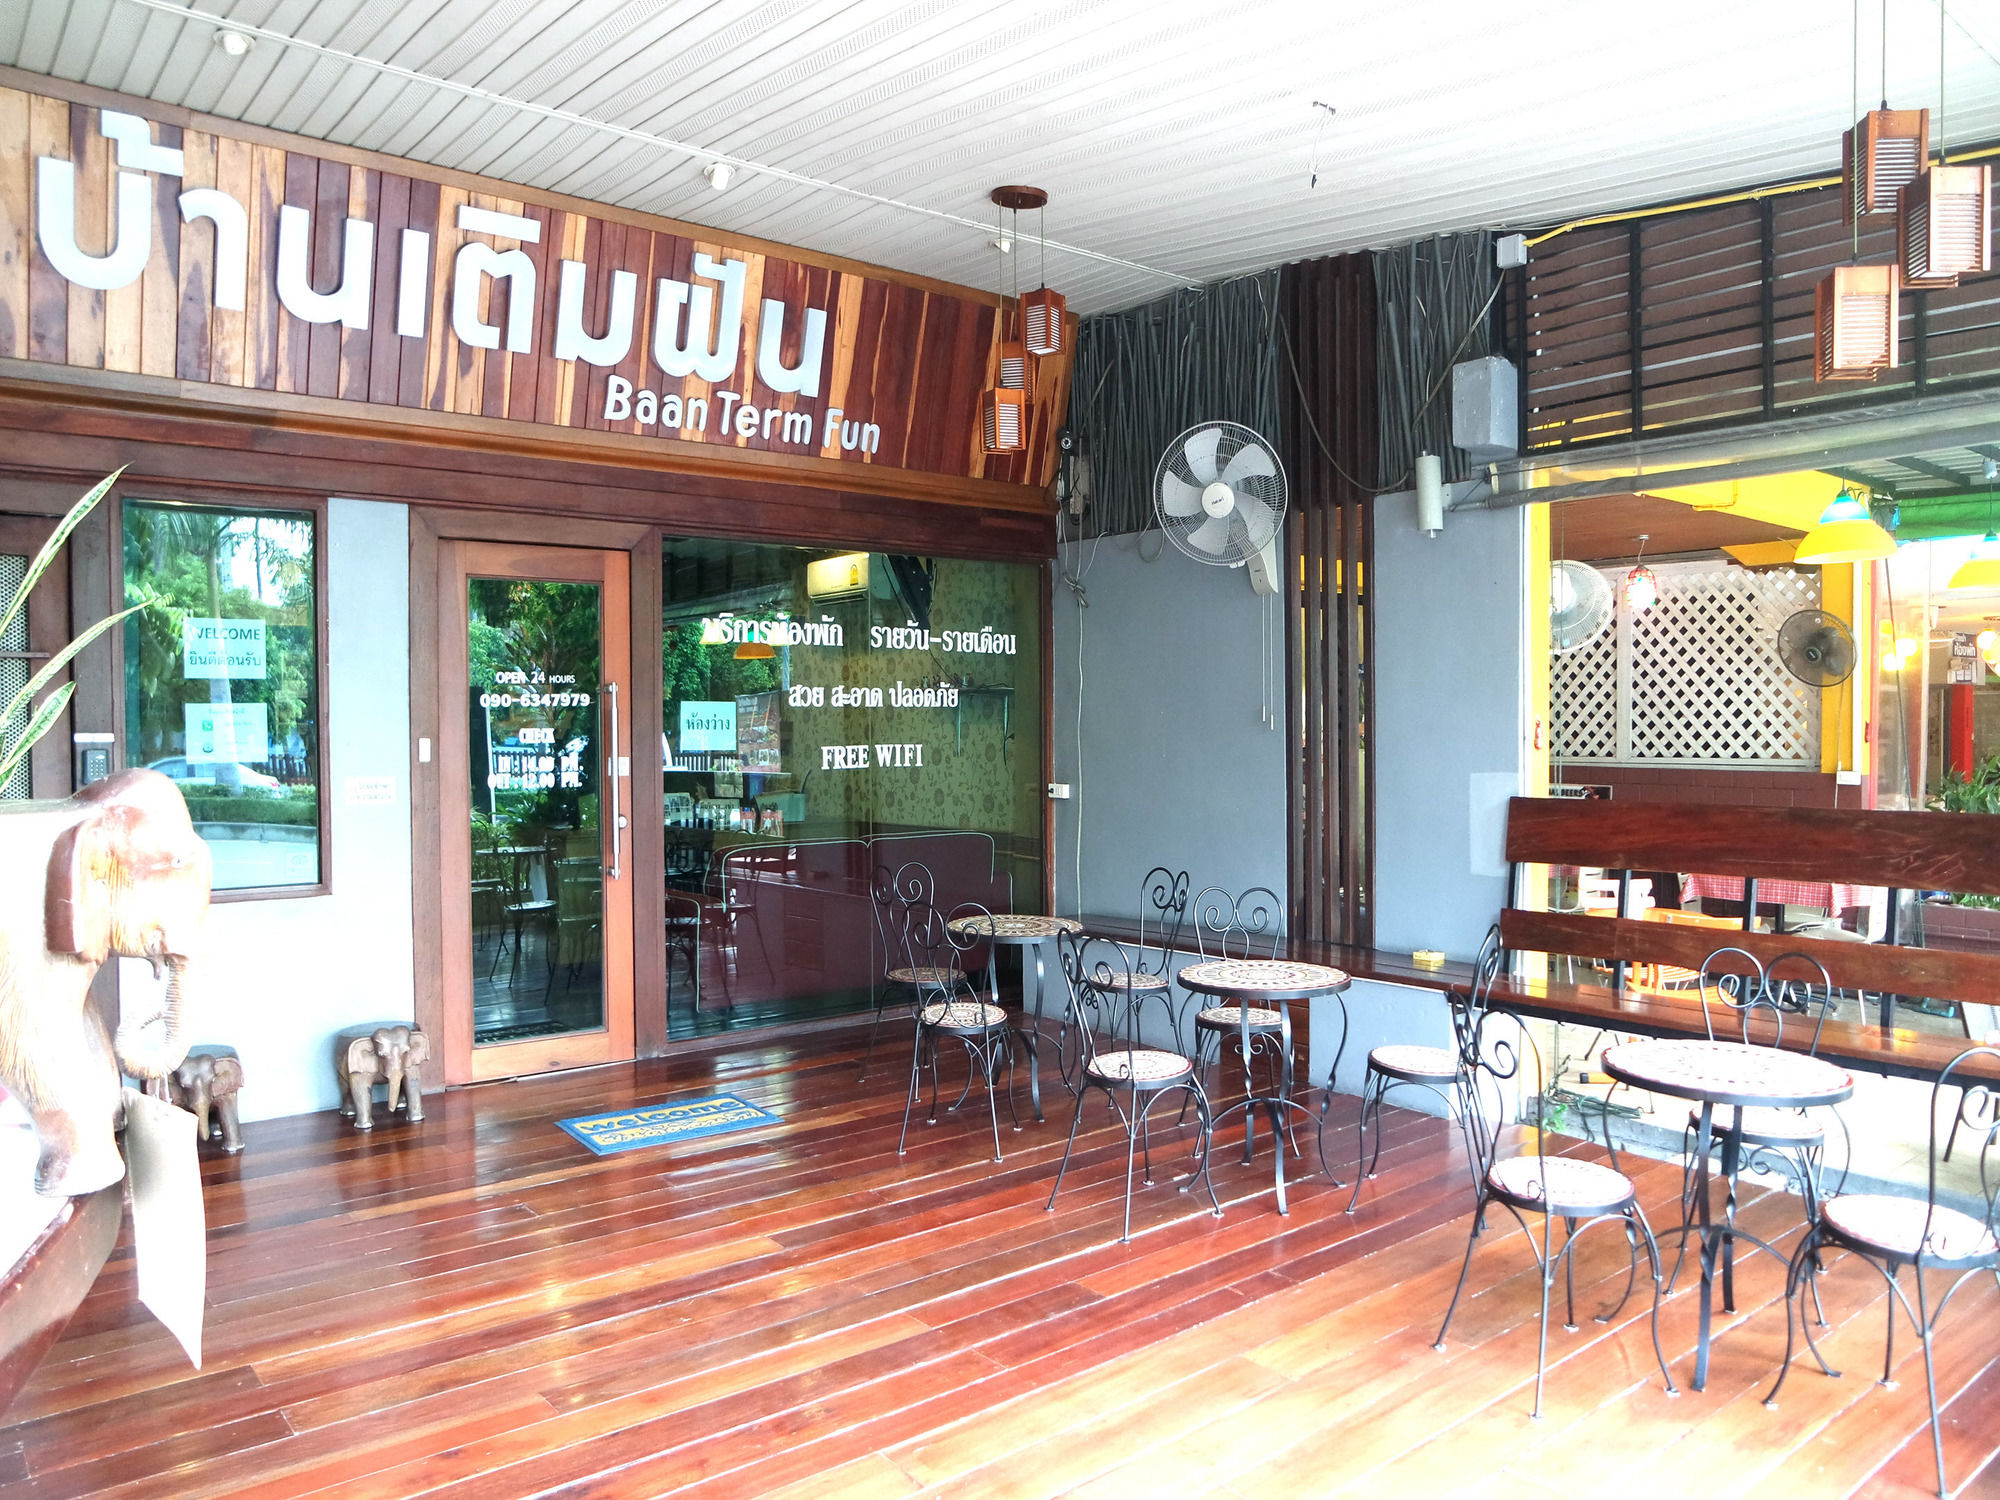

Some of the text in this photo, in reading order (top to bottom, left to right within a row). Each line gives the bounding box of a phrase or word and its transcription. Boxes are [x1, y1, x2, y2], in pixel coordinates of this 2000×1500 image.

[37, 108, 828, 398] บ้านเติมฝัน
[603, 373, 882, 455] Baan Term Fun
[189, 627, 261, 641] WELCOME
[870, 619, 1017, 655] รายวัน-รายเดือน
[495, 671, 576, 684] OPEN 24 HOURS
[479, 693, 591, 708] 090-6347979
[788, 680, 959, 708] สวย สะอาด ปลอดภัย
[686, 711, 730, 731] ห้องว่าง
[519, 728, 556, 744] CHECK
[820, 743, 924, 770] FREE WIFI
[580, 1099, 742, 1133] welcome
